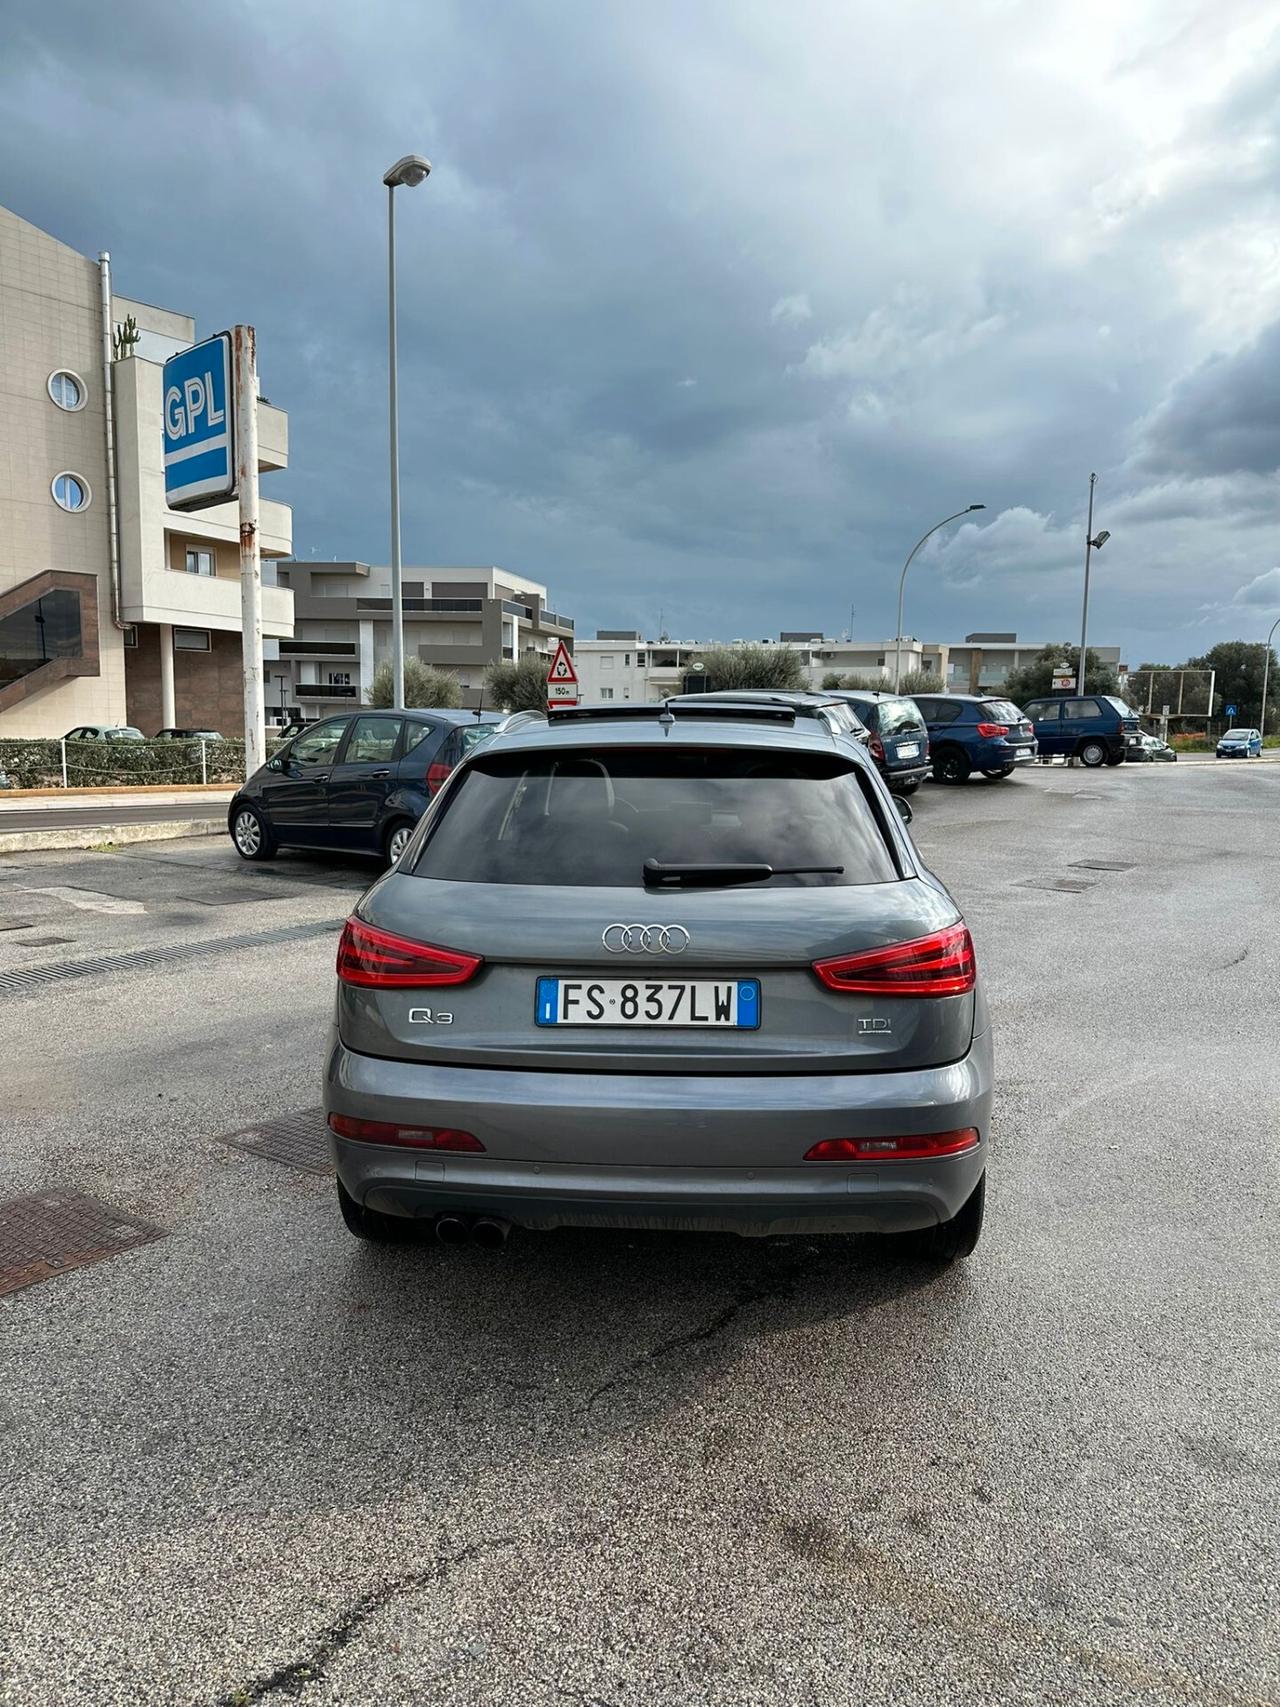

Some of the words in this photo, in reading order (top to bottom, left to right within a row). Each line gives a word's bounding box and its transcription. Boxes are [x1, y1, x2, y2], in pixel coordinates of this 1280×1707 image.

[165, 371, 224, 440] GPL
[409, 1007, 453, 1024] Q3
[858, 1018, 891, 1029] TDI
